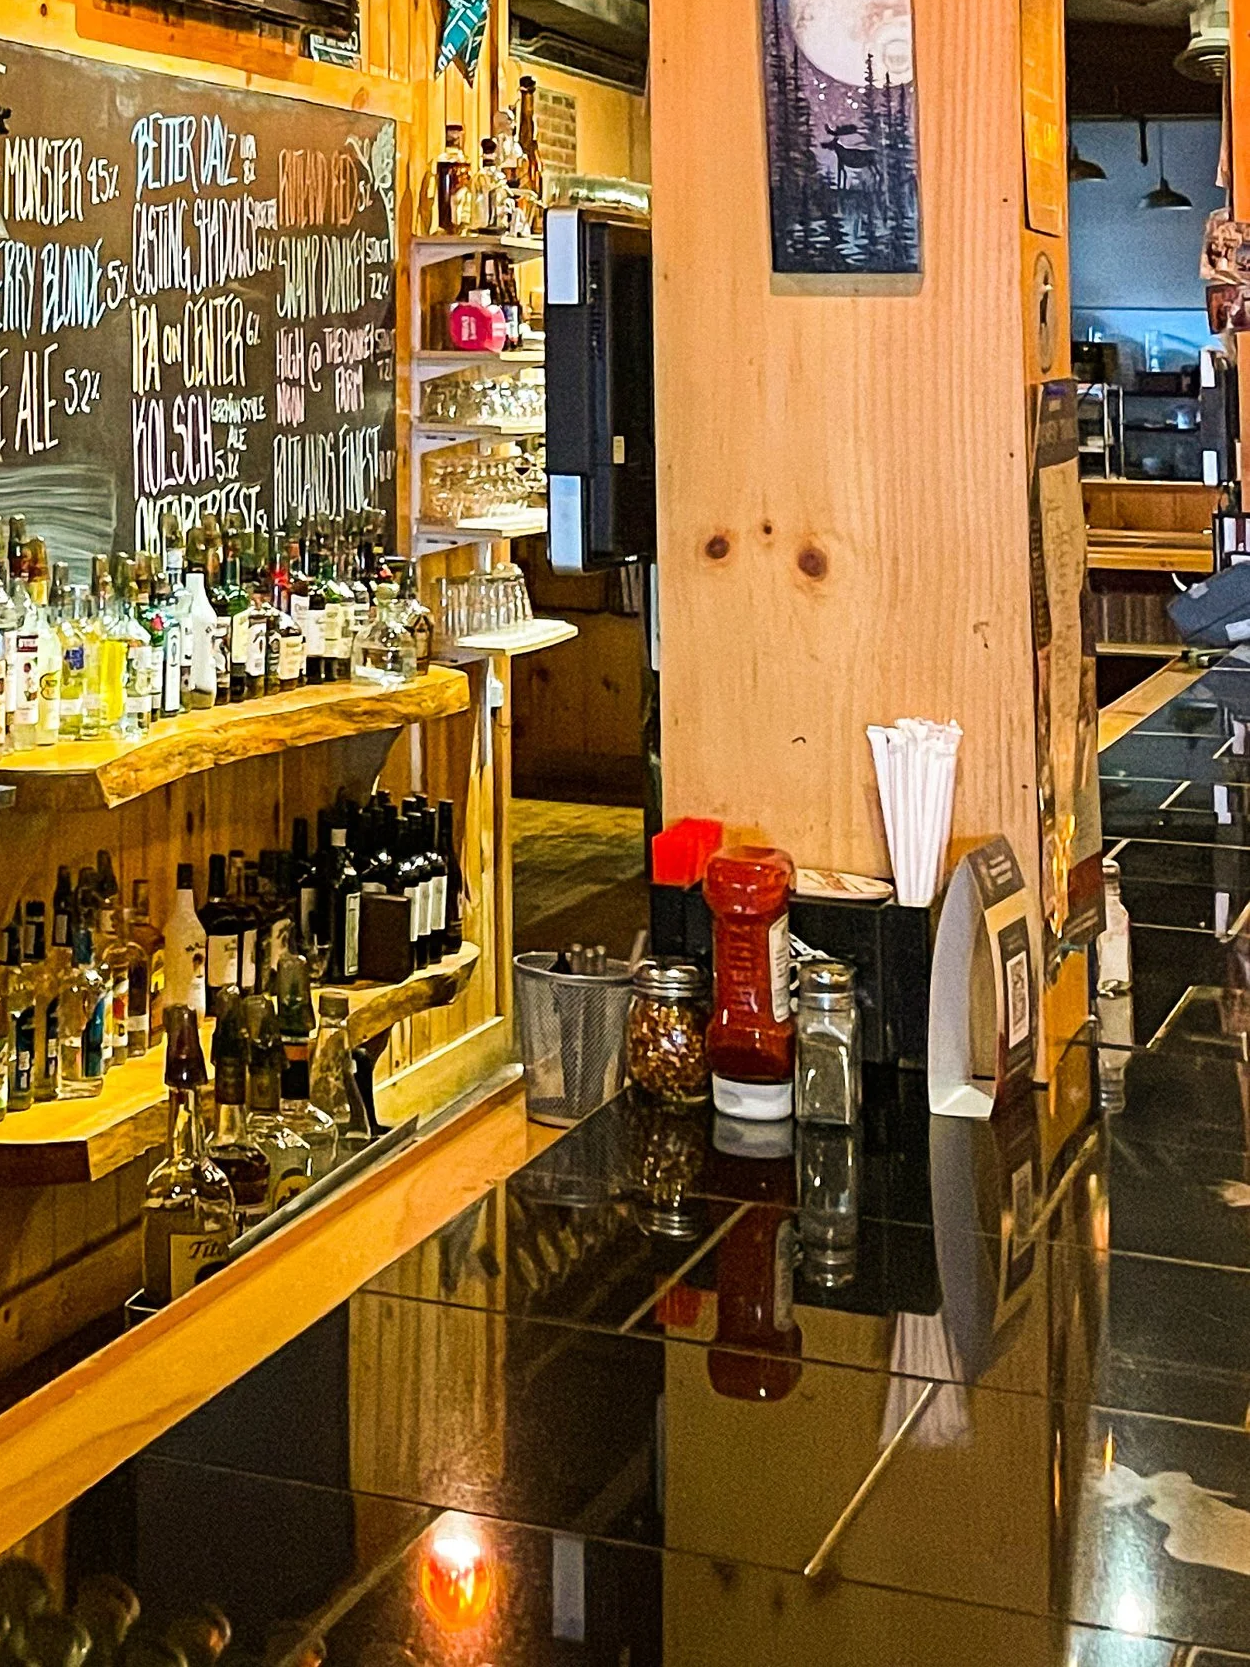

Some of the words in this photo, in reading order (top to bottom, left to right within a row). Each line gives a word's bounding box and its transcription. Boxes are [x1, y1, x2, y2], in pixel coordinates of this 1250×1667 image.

[3, 136, 84, 226] MONSTER
[131, 112, 199, 201] BETTER
[330, 150, 358, 228] RED
[41, 238, 107, 335] BLONDE
[162, 323, 182, 365] ON
[182, 293, 246, 389] CENTER
[14, 342, 59, 455] ALE
[62, 367, 101, 416] 5.2%
[131, 388, 215, 500] KOLSCH
